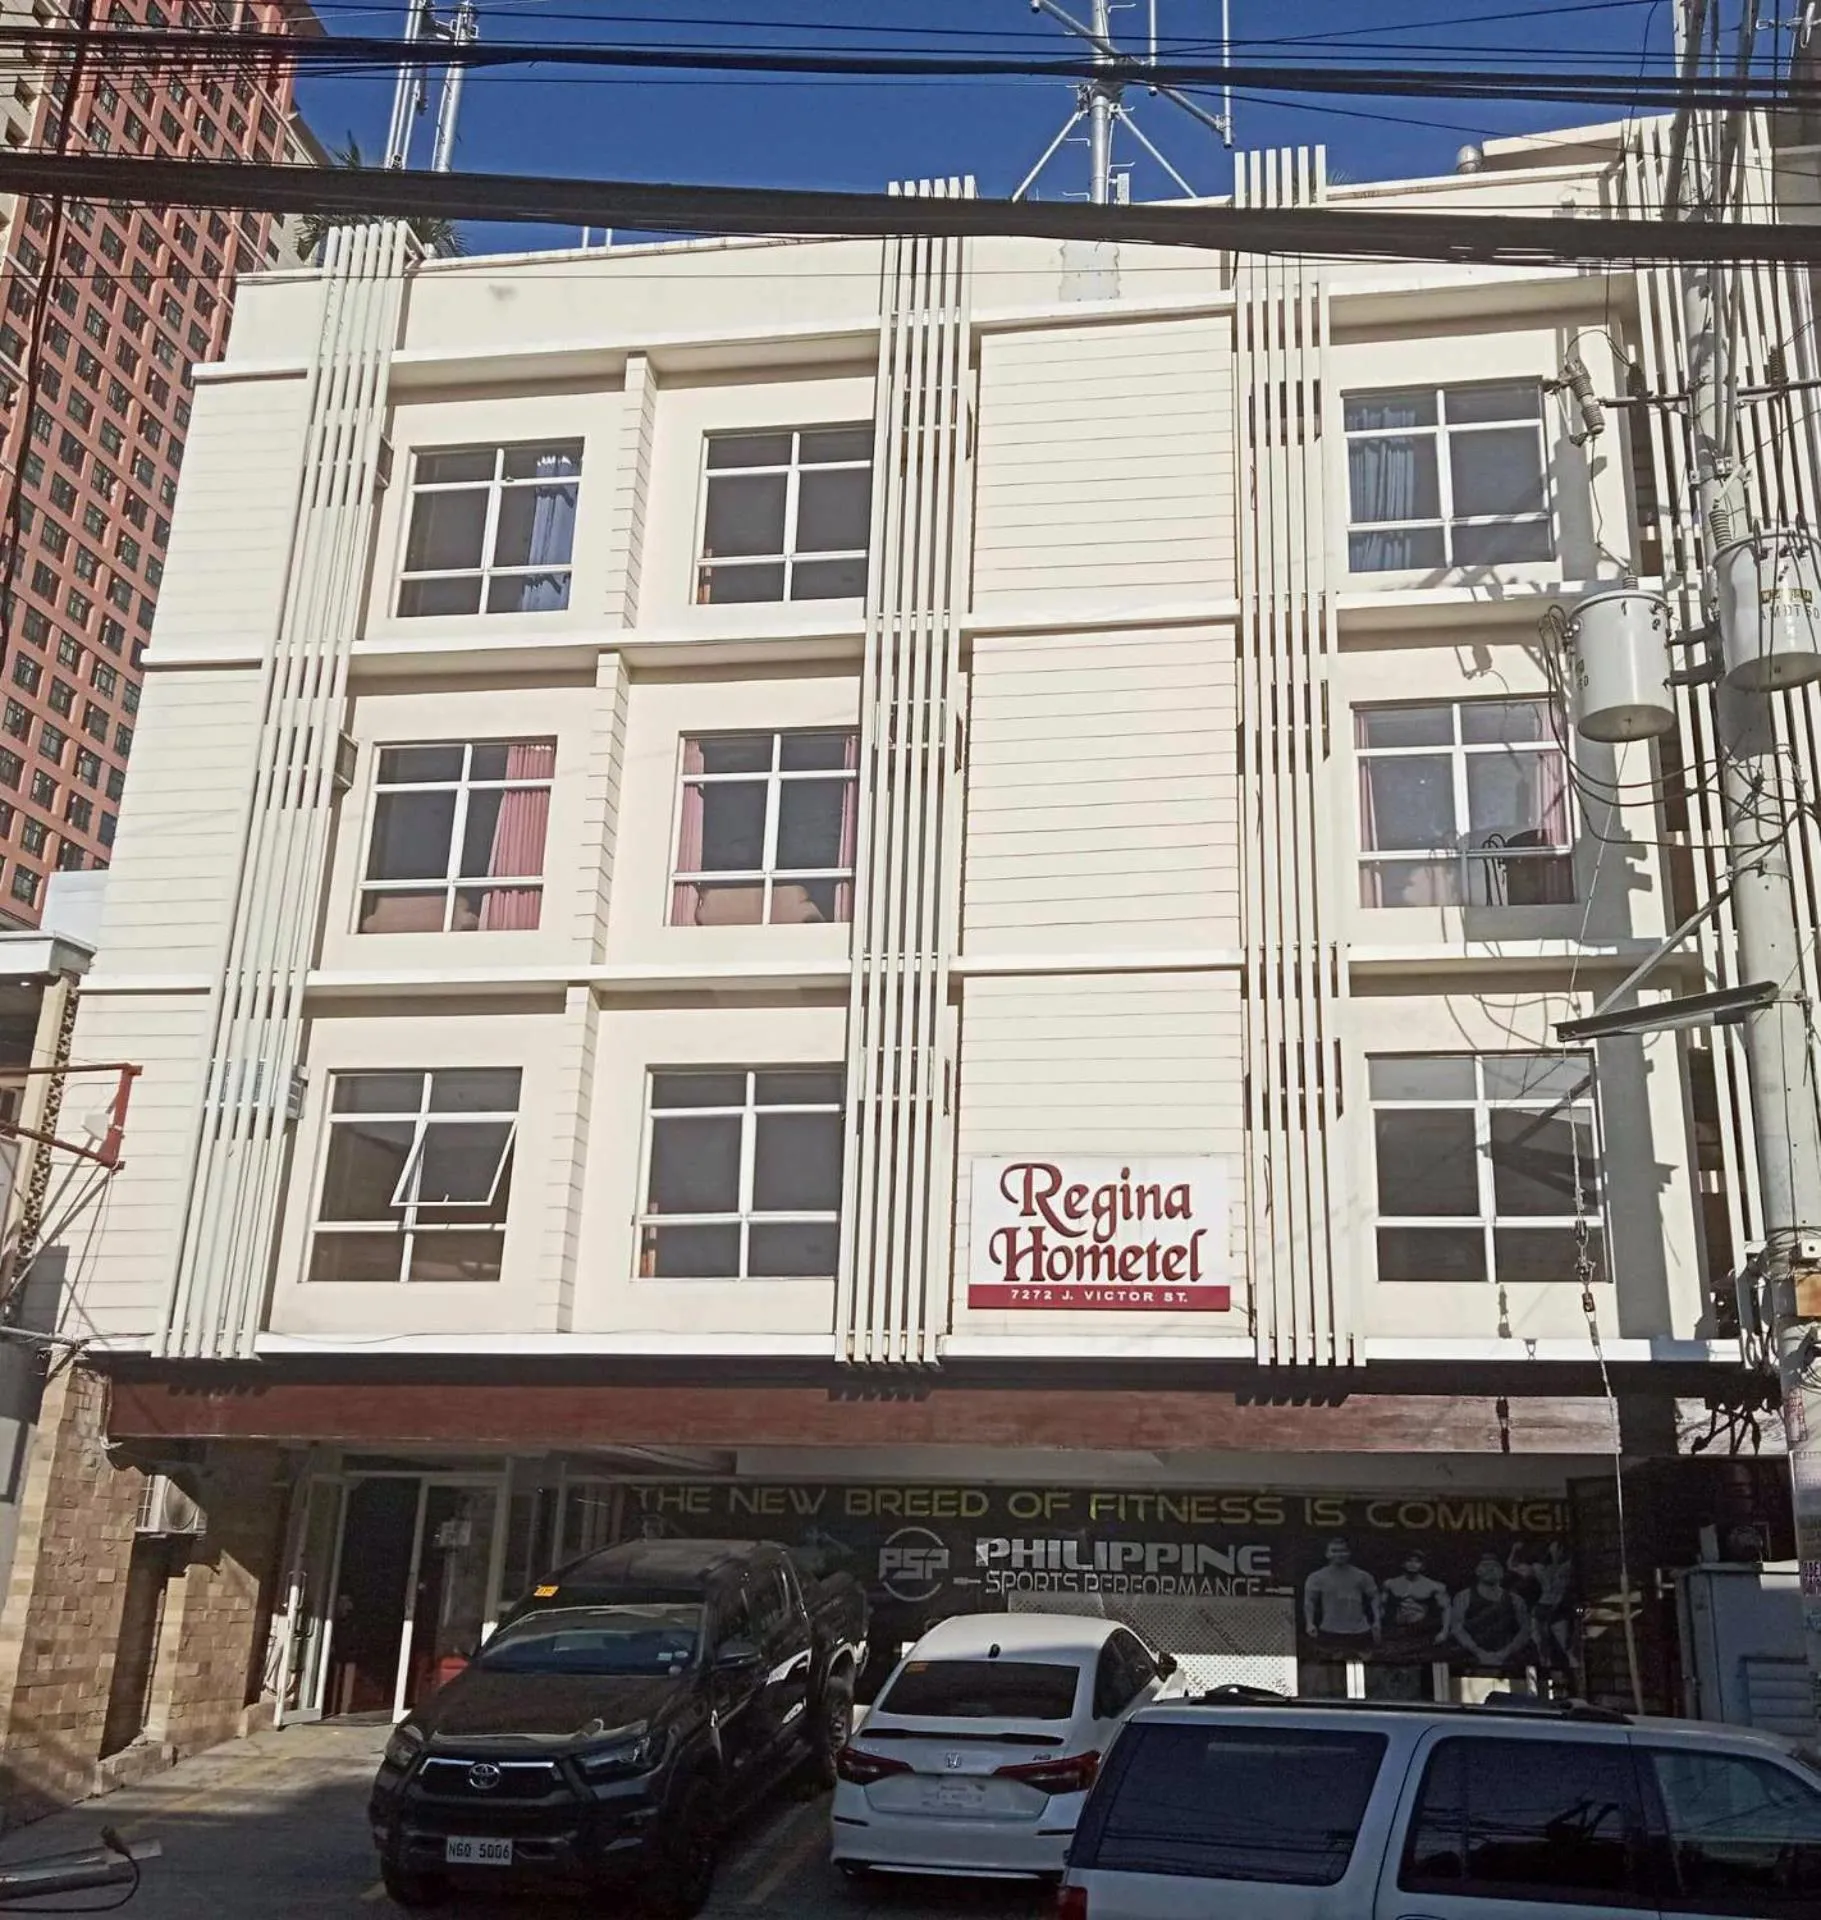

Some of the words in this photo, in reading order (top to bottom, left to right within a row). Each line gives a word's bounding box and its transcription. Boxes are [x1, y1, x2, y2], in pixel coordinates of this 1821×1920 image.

[1000, 1163, 1191, 1243] Regina
[989, 1226, 1208, 1281] Hometel
[1011, 1290, 1052, 1300] 7272
[1062, 1290, 1073, 1300] J.
[1084, 1290, 1154, 1302] VICTOR
[1164, 1292, 1188, 1302] ST.
[634, 1486, 711, 1513] THE
[729, 1488, 827, 1514] NEW
[846, 1489, 989, 1517] BREED
[1008, 1493, 1070, 1519] OF
[1089, 1494, 1284, 1525] FITNESS
[1305, 1498, 1346, 1526] IS
[879, 1548, 949, 1580] PSP
[975, 1538, 1271, 1575] PHILIPPINE
[986, 1571, 1077, 1594] SPORTS
[1084, 1574, 1262, 1596] PERFORMANCE
